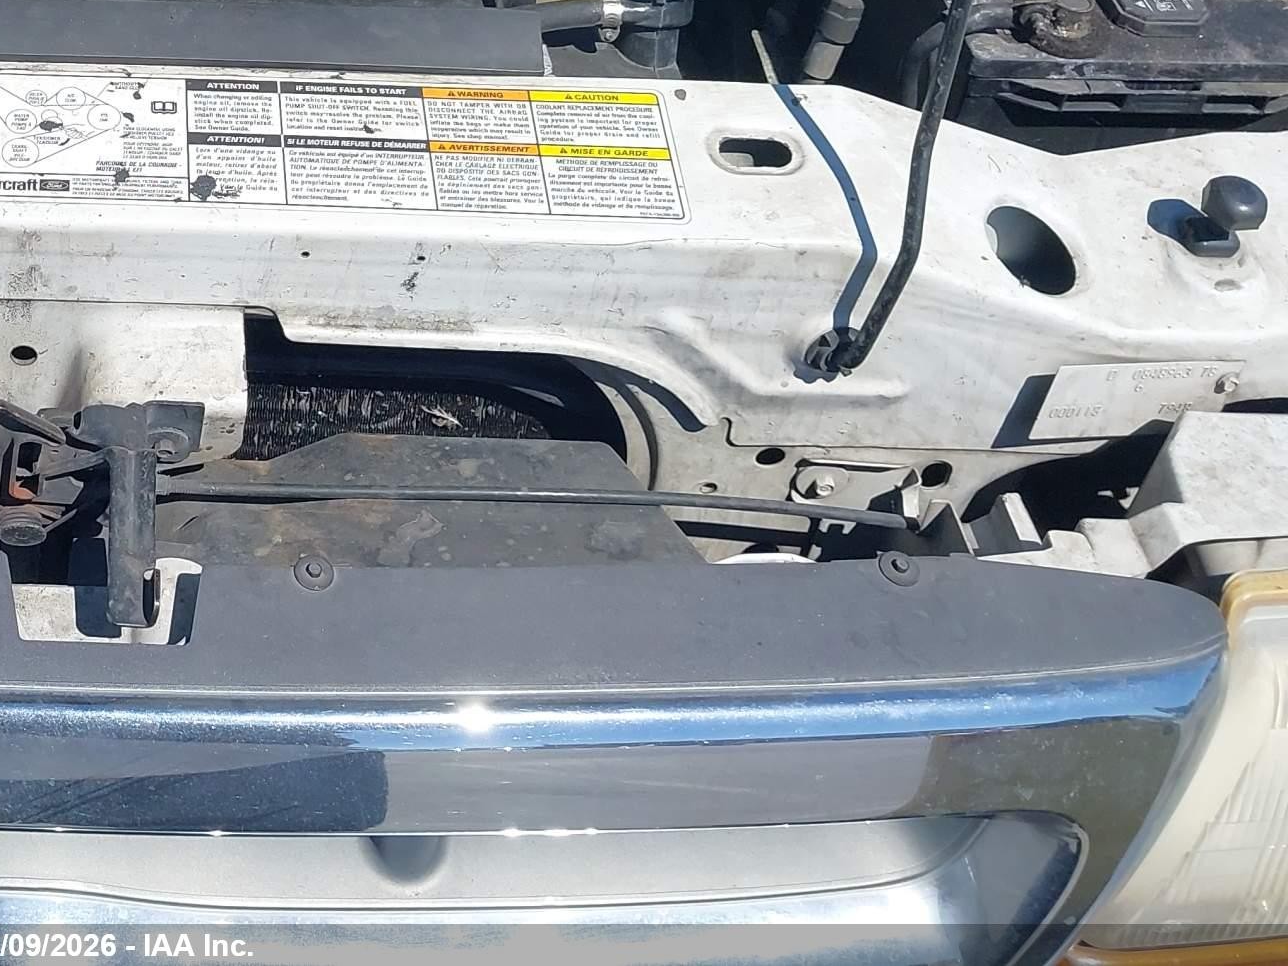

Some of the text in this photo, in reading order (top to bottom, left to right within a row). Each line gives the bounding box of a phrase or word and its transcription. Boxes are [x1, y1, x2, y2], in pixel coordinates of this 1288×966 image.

[206, 82, 259, 90] ATTENTION
[378, 87, 407, 95] START
[456, 91, 504, 99] WARNING
[206, 136, 265, 144] ATTENTION!
[383, 141, 426, 149] DÉMARRER
[448, 144, 531, 153] AVERTISSEMENT
